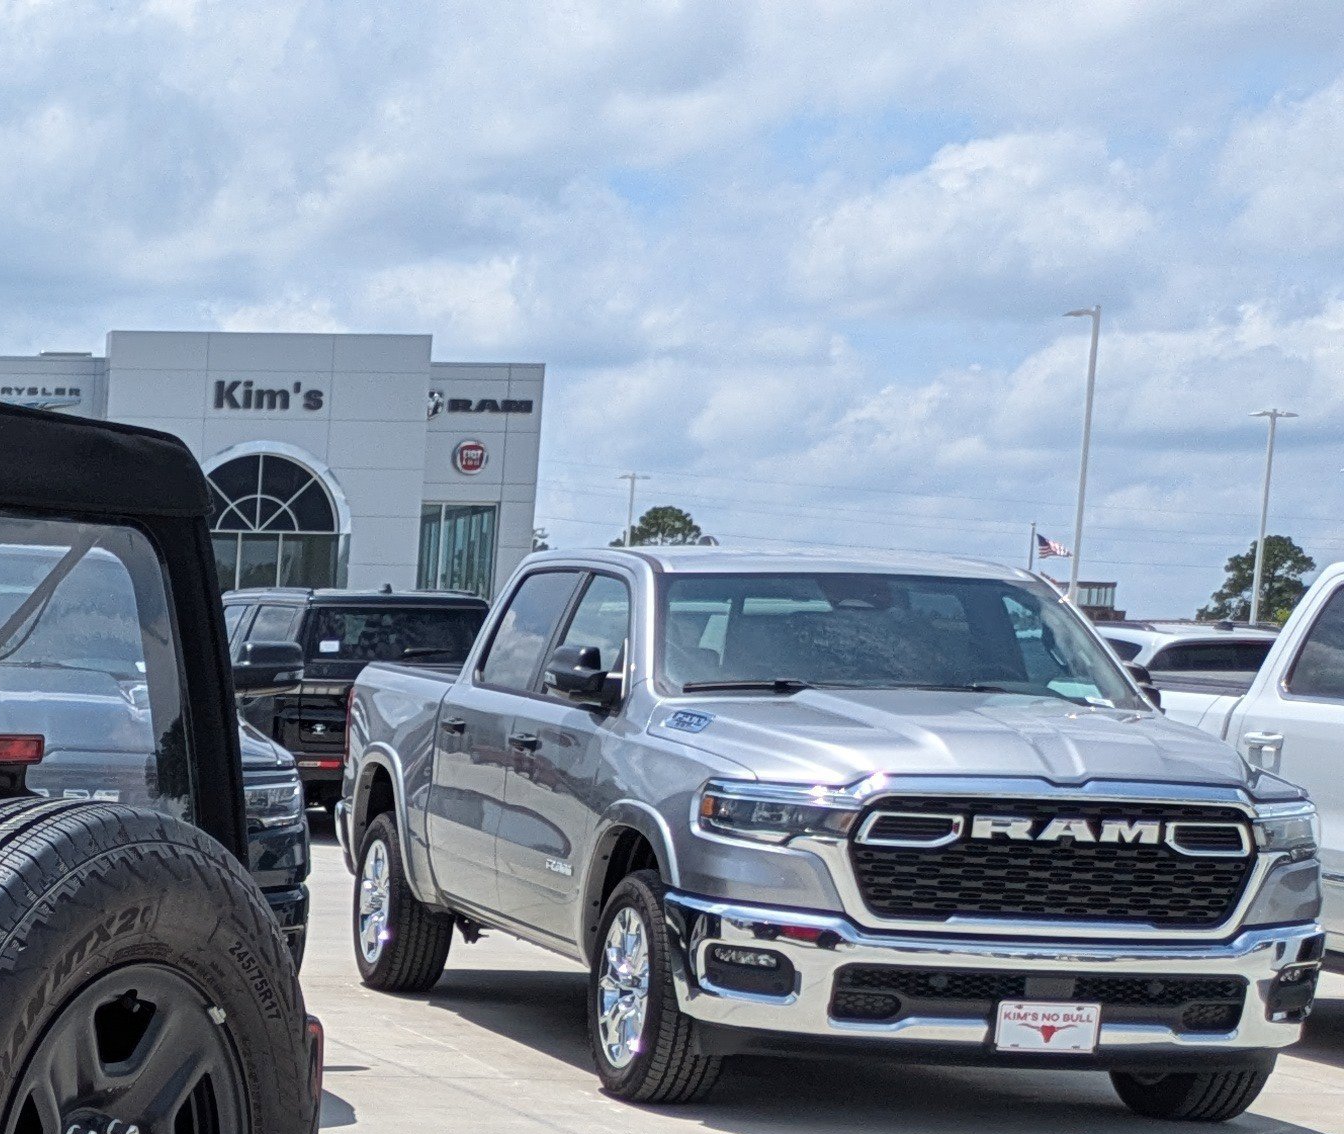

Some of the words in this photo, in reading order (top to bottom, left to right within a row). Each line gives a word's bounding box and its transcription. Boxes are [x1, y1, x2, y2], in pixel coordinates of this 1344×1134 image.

[214, 380, 323, 411] Kim's
[447, 399, 533, 413] RAM
[970, 814, 1162, 845] RAM
[227, 934, 282, 1030] 245/75R17
[1003, 1011, 1039, 1021] KIM'S
[1041, 1012, 1060, 1022] NO
[1062, 1013, 1093, 1023] BULL
